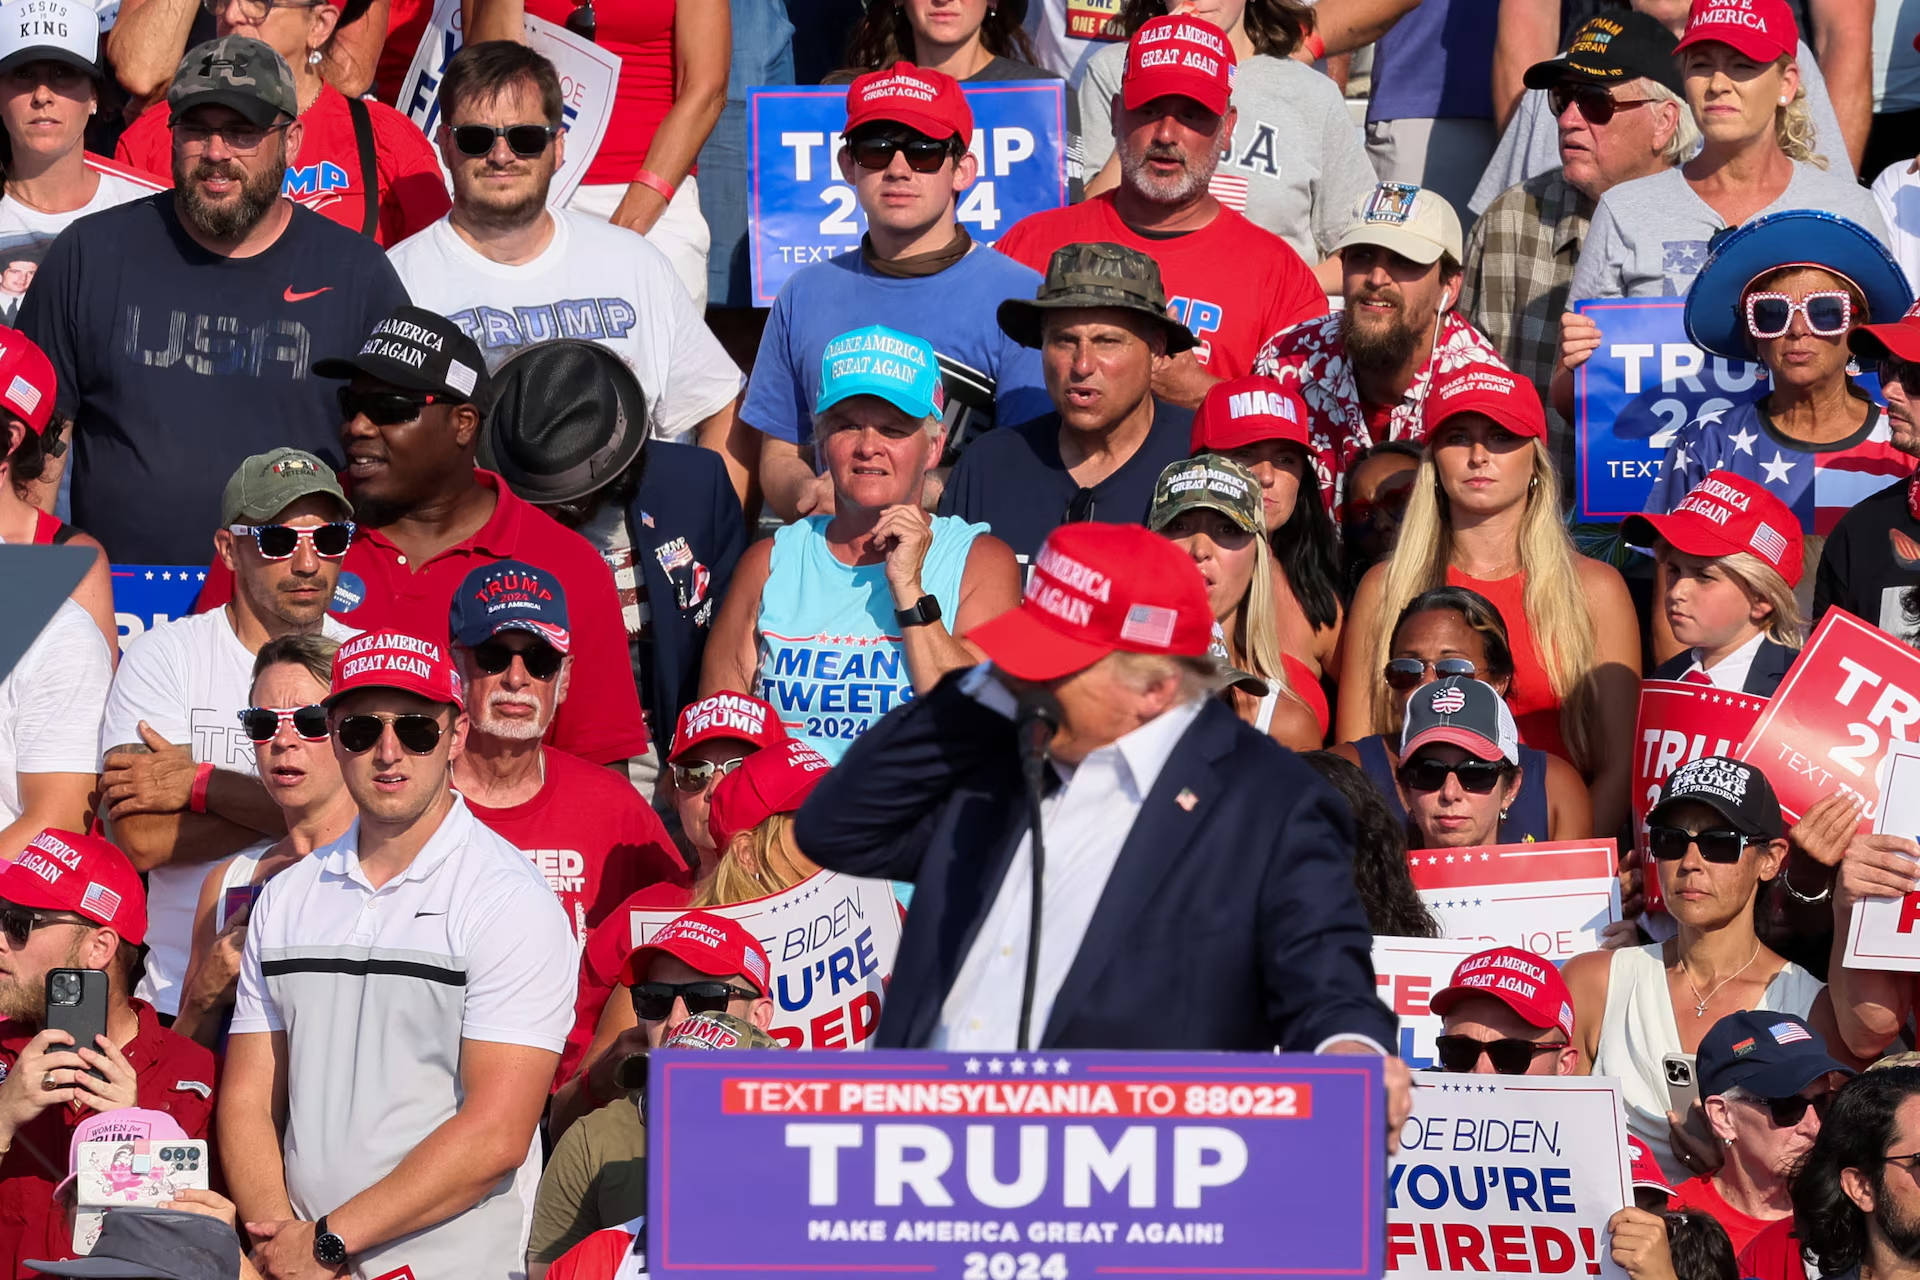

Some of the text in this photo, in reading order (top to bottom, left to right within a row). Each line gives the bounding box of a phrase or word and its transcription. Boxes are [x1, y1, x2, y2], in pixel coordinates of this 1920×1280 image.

[20, 1, 67, 17] JESUS
[1691, 9, 1768, 33] AMERICA
[20, 21, 67, 38] KING
[1072, 16, 1096, 33] ONE
[1138, 25, 1226, 57] MAKE AMERICA
[1140, 49, 1219, 77] GREAT AGAIN
[559, 75, 586, 108] OE
[863, 86, 933, 102] GREAT AGAIN
[890, 75, 938, 96] AMERICA
[380, 318, 444, 352] AMERICA
[445, 297, 638, 349] TRUMP
[124, 304, 312, 381] USA
[378, 341, 427, 369] AGAIN
[825, 334, 926, 367] MAKE AMERICA
[832, 356, 918, 385] GREAT AGAIN
[1440, 372, 1516, 395] MAKE AMERICA
[1442, 382, 1511, 400] GREAT AGAIN
[1229, 391, 1298, 424] MAGA
[1166, 467, 1249, 492] MAKE AMERICA
[1170, 480, 1241, 500] GREAT AGAIN
[1687, 497, 1733, 526] AGAIN
[475, 575, 554, 602] TRUMP
[488, 603, 506, 614] SAVE
[1036, 585, 1095, 628] AGAIN
[337, 633, 440, 663] MAKE AMERICA
[342, 655, 431, 680] GREAT AGAIN
[774, 647, 901, 681] MEAN
[685, 694, 766, 722] WOMEN
[761, 680, 916, 715] TWEETS
[685, 711, 763, 740] TRUMP
[806, 717, 870, 740] 2024
[1676, 758, 1751, 780] JESUS
[1702, 767, 1747, 788] SAVIOR
[1777, 742, 1833, 788] TEXT
[1672, 773, 1747, 797] TRUMP
[1689, 784, 1743, 806] PRESIDENT
[673, 920, 728, 942] AMERICA
[782, 886, 864, 962] BIDEN,
[678, 929, 719, 949] AGAIN
[1458, 955, 1547, 985] MAKE AMERICA
[1496, 975, 1536, 999] AGAIN
[738, 1082, 1297, 1116] TEXT PENNSYLVANIA TO 88022
[91, 1124, 128, 1137] WOMEN
[1399, 1116, 1561, 1157] OE BIDEN,
[785, 1123, 1249, 1209] TRUMP
[807, 1220, 1225, 1244] MAKE AMERICA GREAT AGAIN!
[1387, 1223, 1602, 1276] FIRED!
[963, 1251, 1069, 1280] 2024
